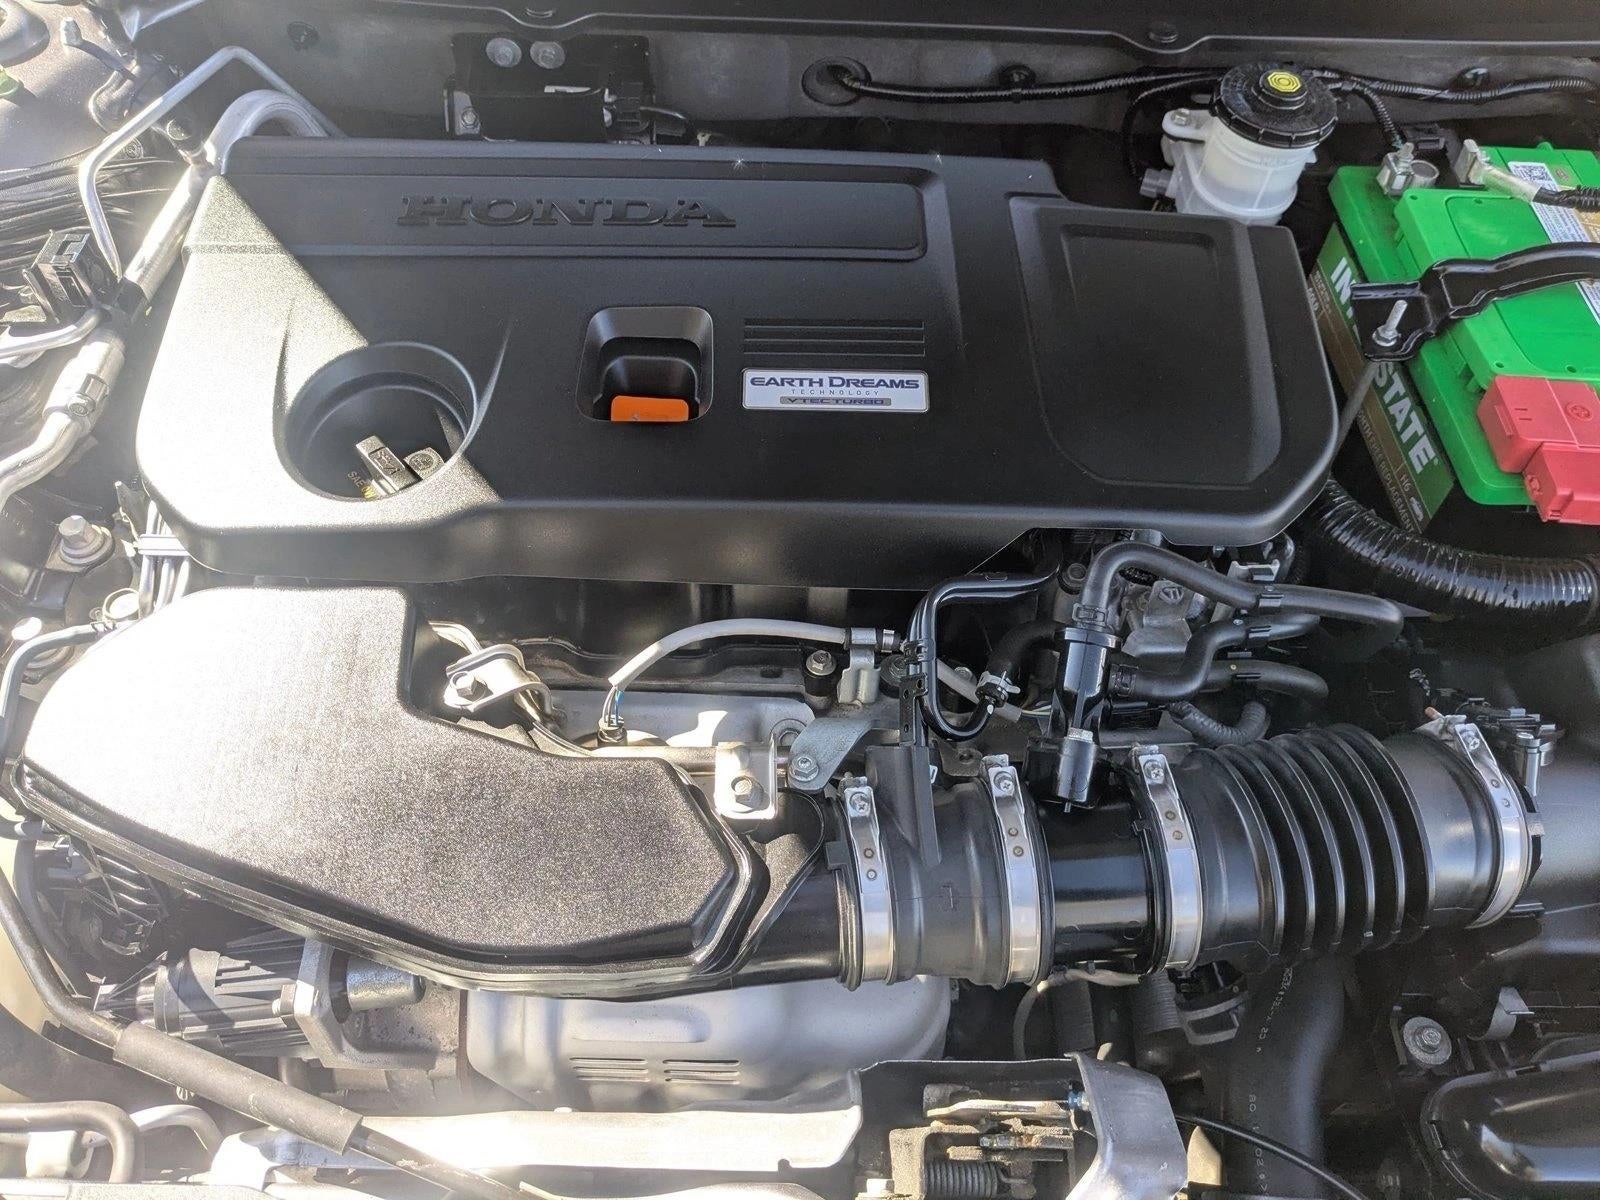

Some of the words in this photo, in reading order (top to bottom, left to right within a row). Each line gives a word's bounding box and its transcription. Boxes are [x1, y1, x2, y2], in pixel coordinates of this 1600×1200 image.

[397, 197, 737, 227] HONDA
[749, 376, 824, 388] EARTH
[828, 376, 920, 389] DREAMS
[348, 471, 364, 488] SAE
